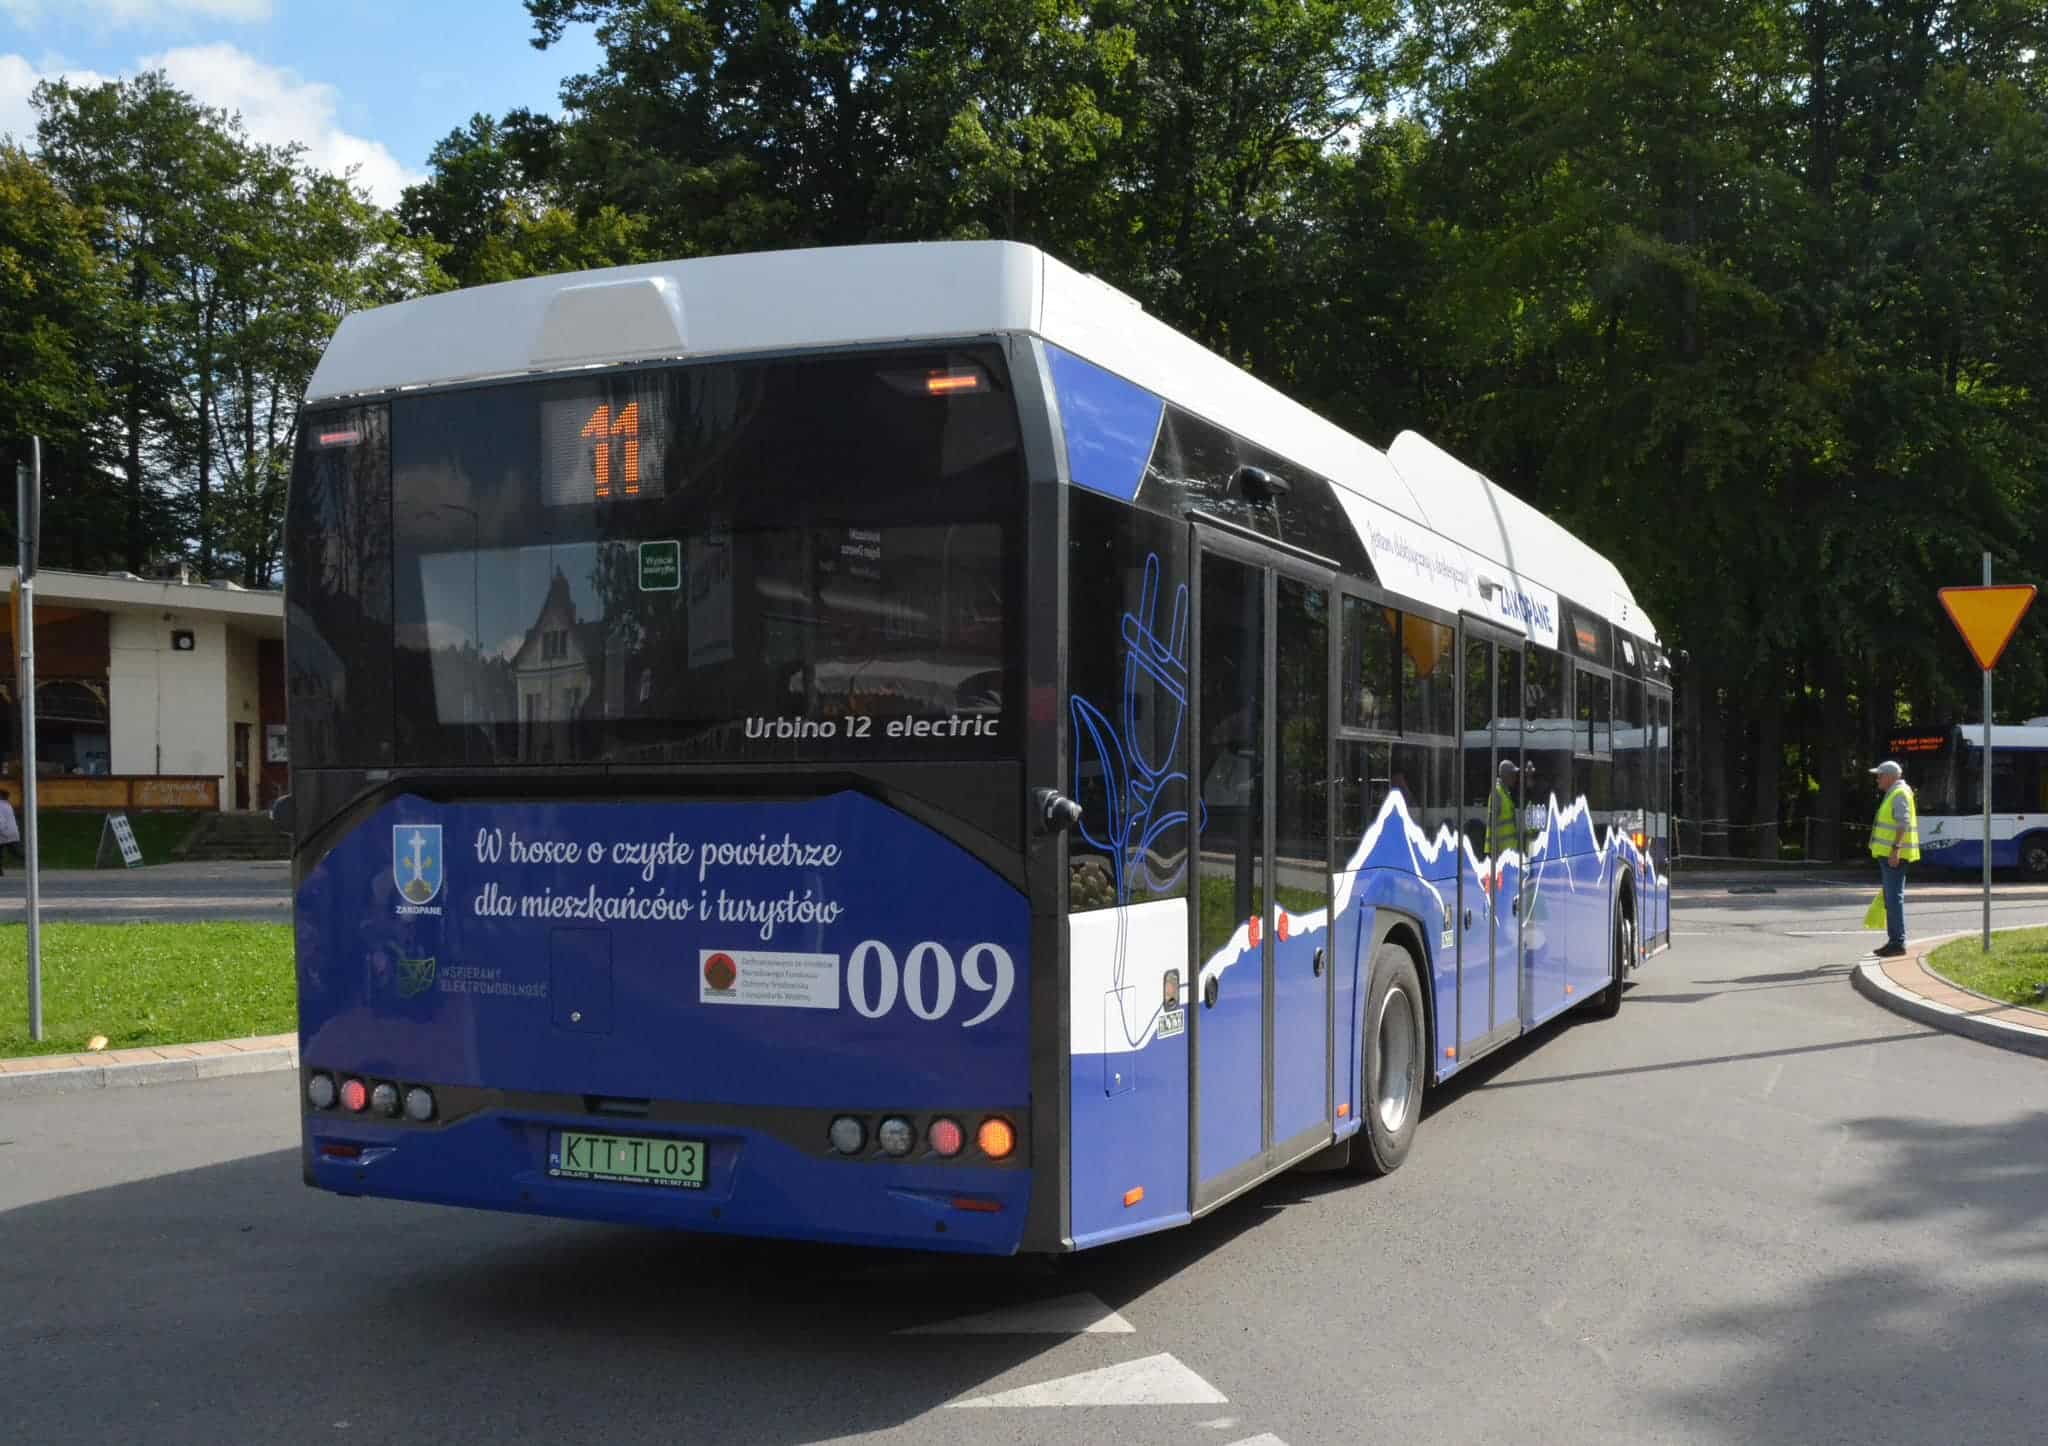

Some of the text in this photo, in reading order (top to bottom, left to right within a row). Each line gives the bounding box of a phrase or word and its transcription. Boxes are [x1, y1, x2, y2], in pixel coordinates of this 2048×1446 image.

[580, 402, 639, 496] 11
[745, 714, 999, 738] Urbino 12 electric
[474, 827, 842, 882] W trosce o czyste powietrze
[396, 905, 442, 915] ZAKOPANE
[474, 882, 844, 940] dla mieszkańców i turystów
[847, 940, 1015, 1027] 009
[567, 1136, 696, 1176] KTT TL03
